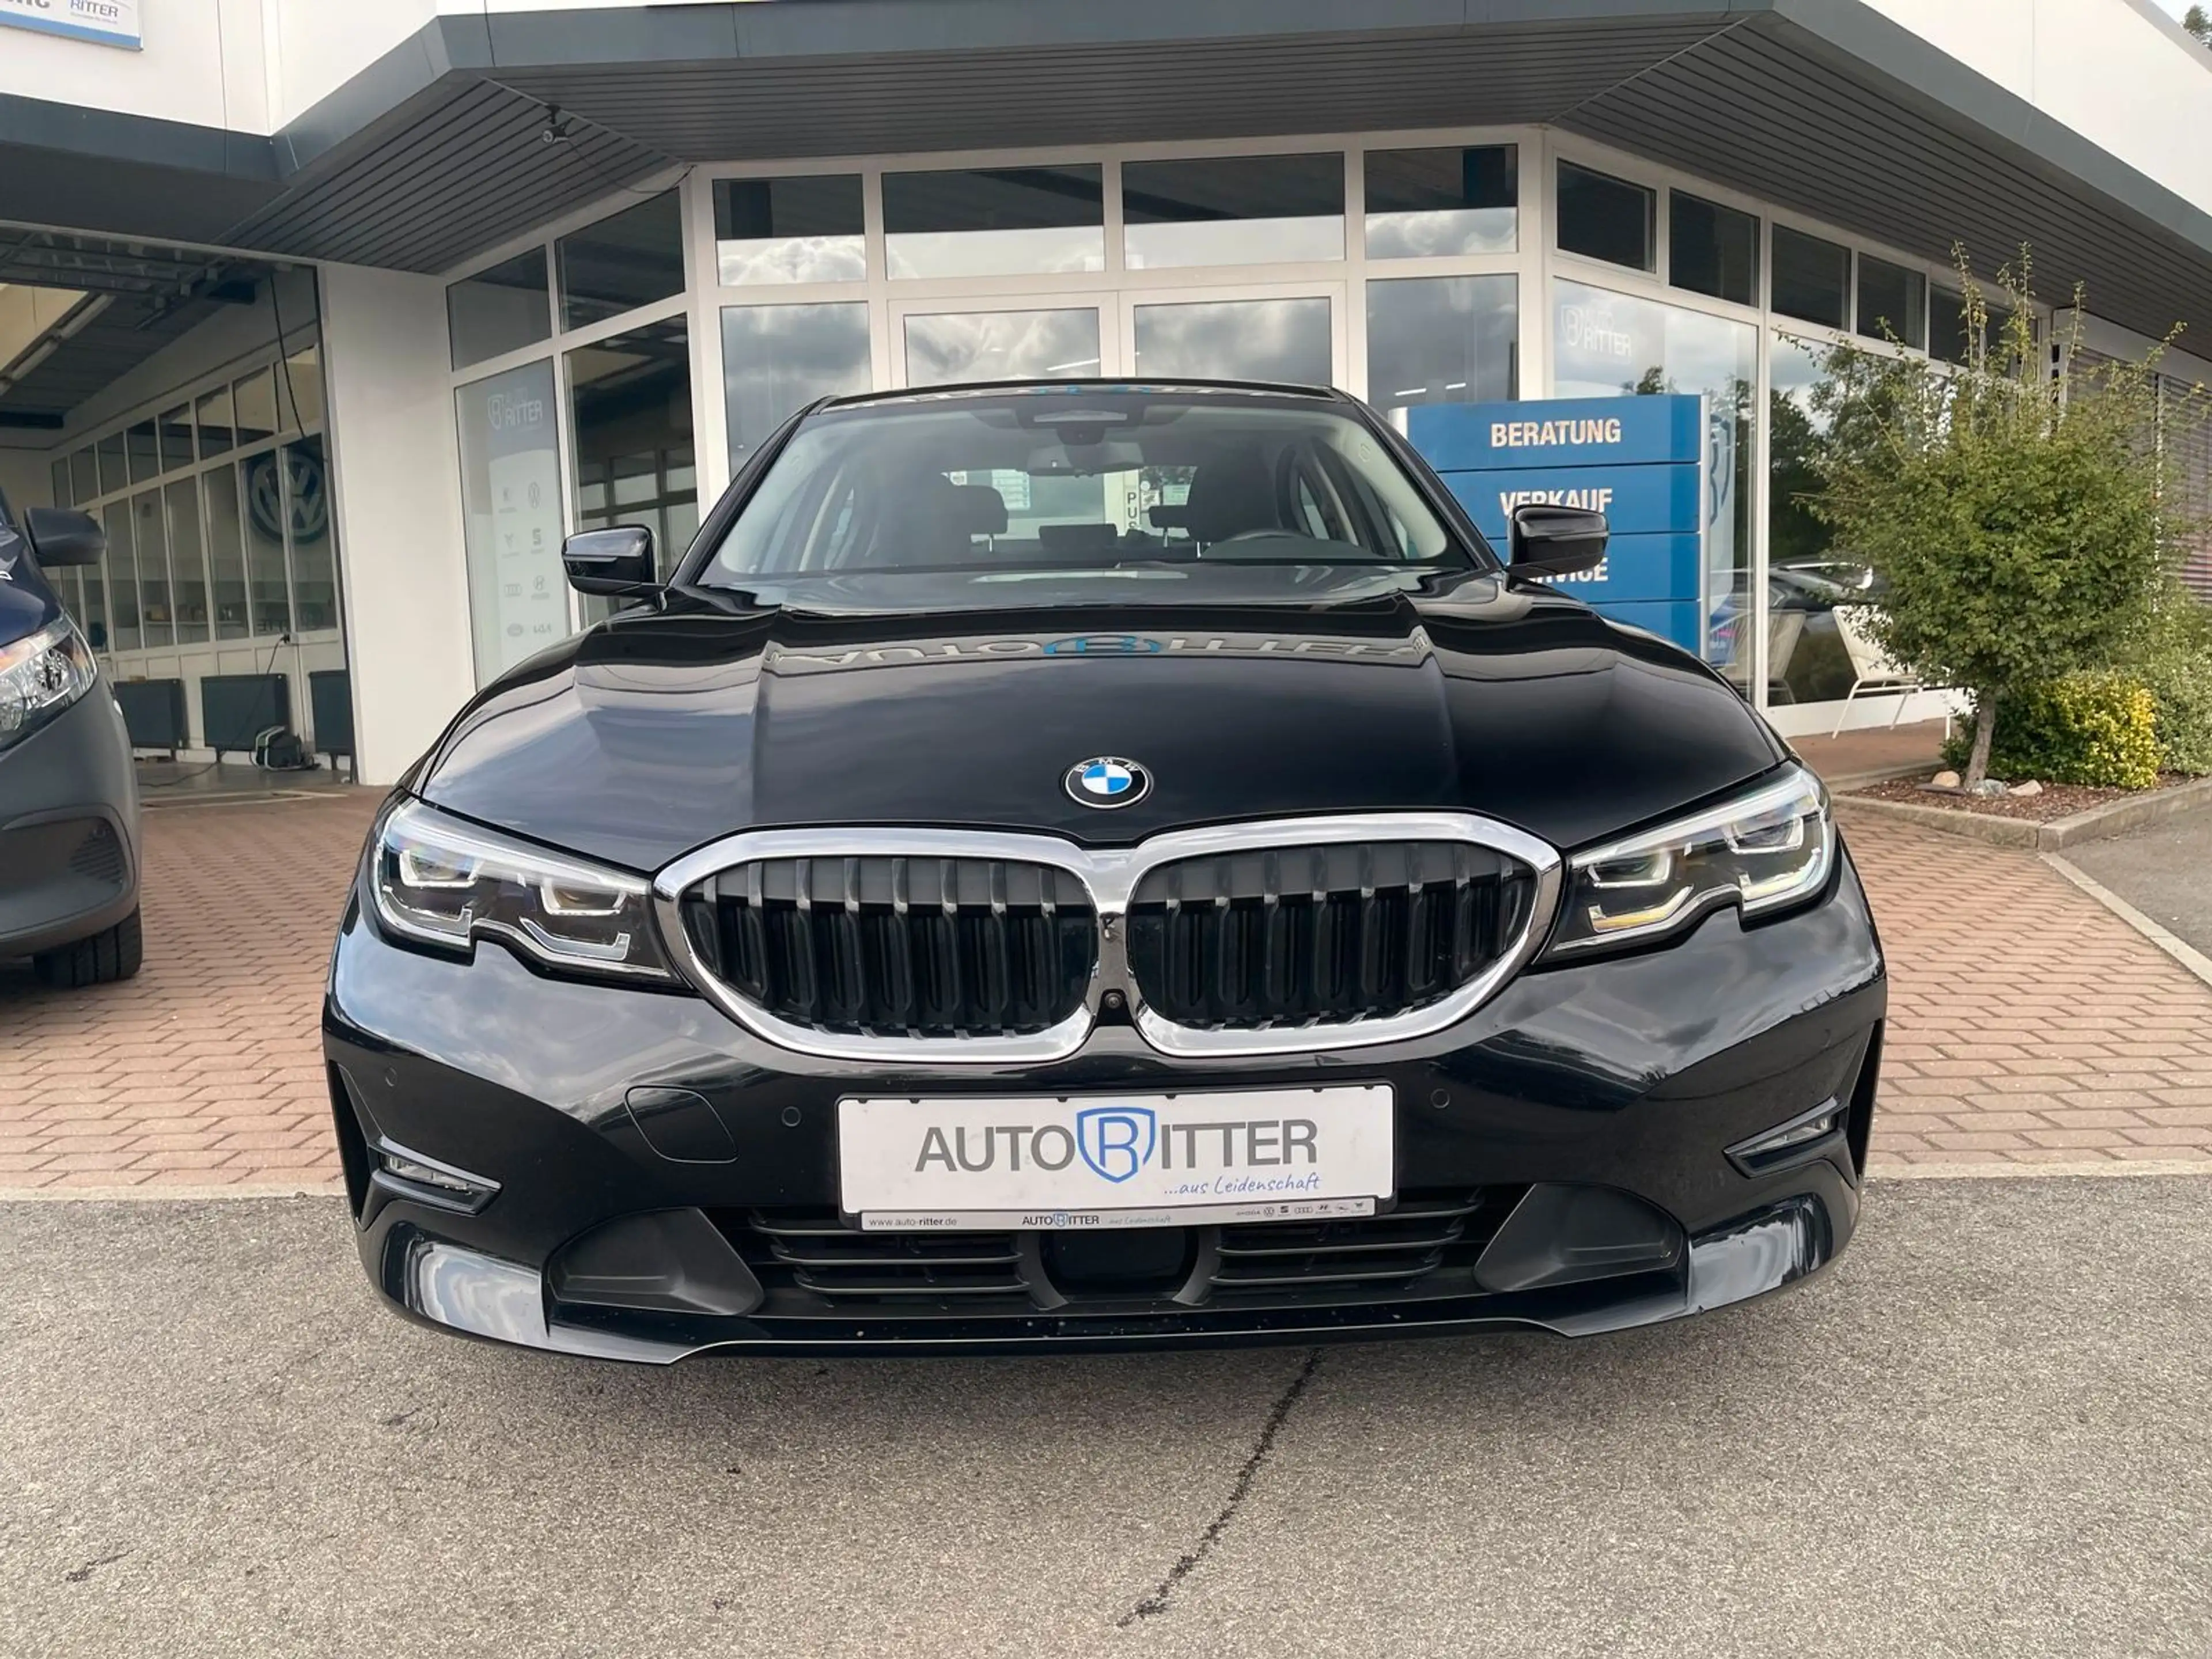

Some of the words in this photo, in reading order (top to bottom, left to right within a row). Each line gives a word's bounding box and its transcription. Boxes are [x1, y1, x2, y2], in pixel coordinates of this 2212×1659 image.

[70, 0, 118, 17] RITTER
[1584, 325, 1632, 357] RITTER
[505, 400, 543, 426] RITTER
[1491, 418, 1622, 448] BERATUNG
[1214, 1172, 1321, 1195] Leidenschaft
[868, 1216, 958, 1226] www.auto-ritter.de
